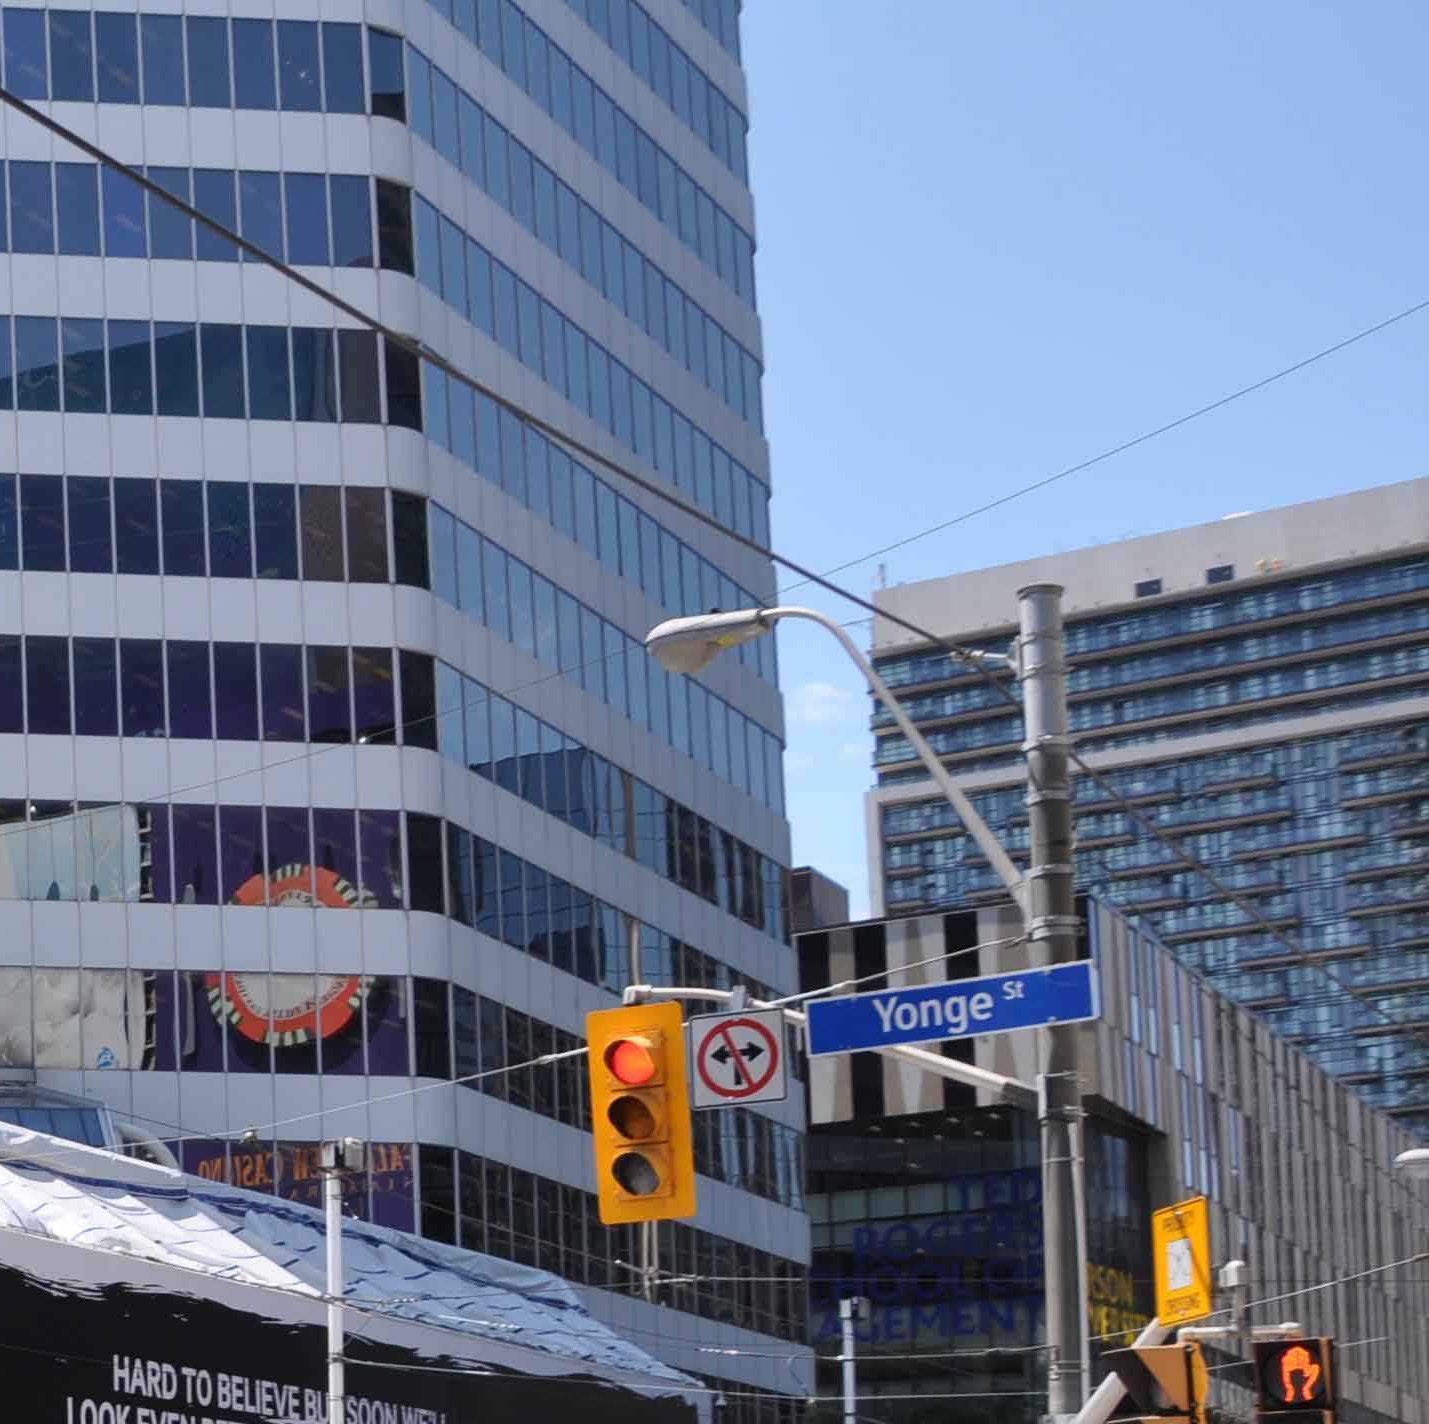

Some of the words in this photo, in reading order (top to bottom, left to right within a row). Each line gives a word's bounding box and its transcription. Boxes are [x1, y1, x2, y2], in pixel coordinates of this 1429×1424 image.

[873, 992, 994, 1034] Yonge
[1002, 981, 1025, 1000] St
[112, 1353, 177, 1400] HARD
[181, 1368, 213, 1407] TO
[217, 1371, 300, 1420] BELIEVE
[304, 1390, 329, 1424] BU
